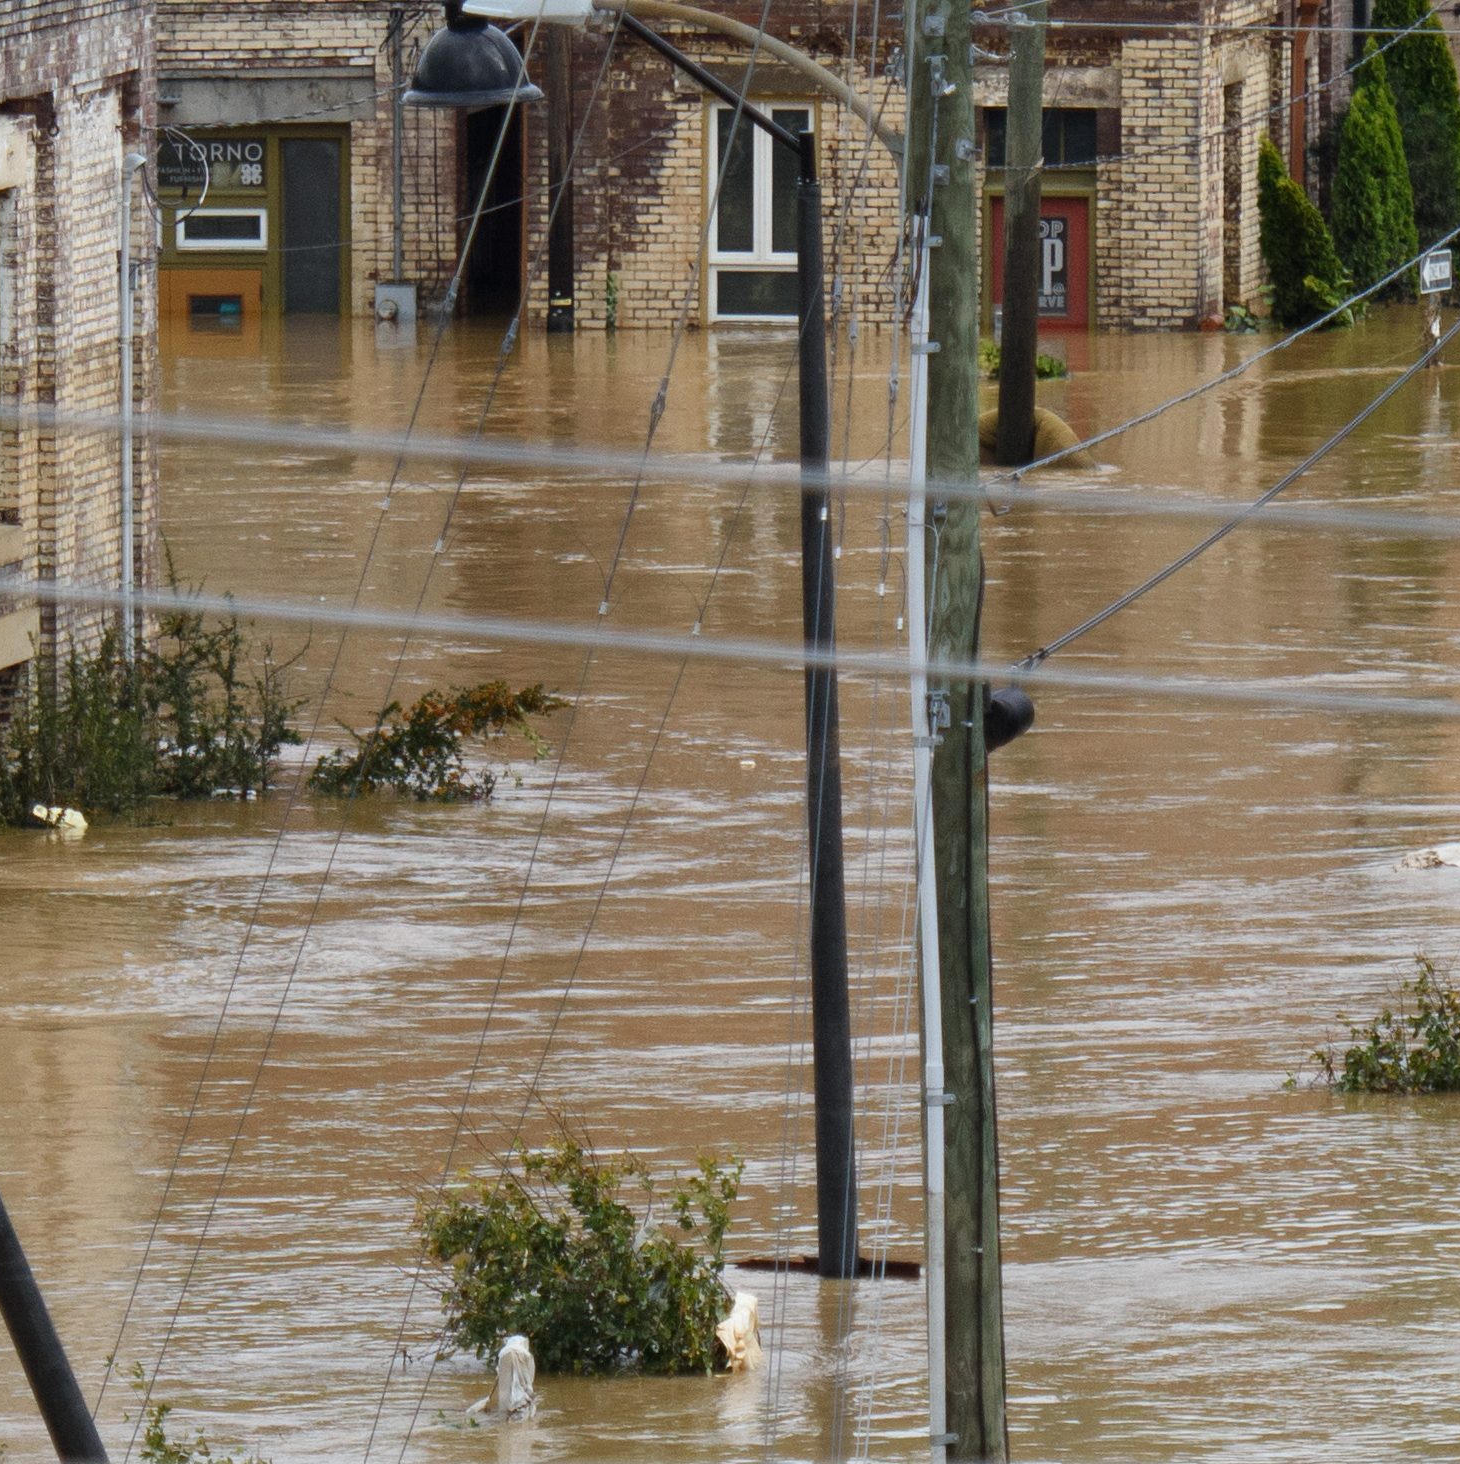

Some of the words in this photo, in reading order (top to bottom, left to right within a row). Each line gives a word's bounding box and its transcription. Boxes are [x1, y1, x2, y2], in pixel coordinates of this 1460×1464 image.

[173, 143, 262, 161] TORNO
[1039, 220, 1064, 238] OP
[1043, 238, 1064, 295] P
[1038, 296, 1065, 307] RVE
